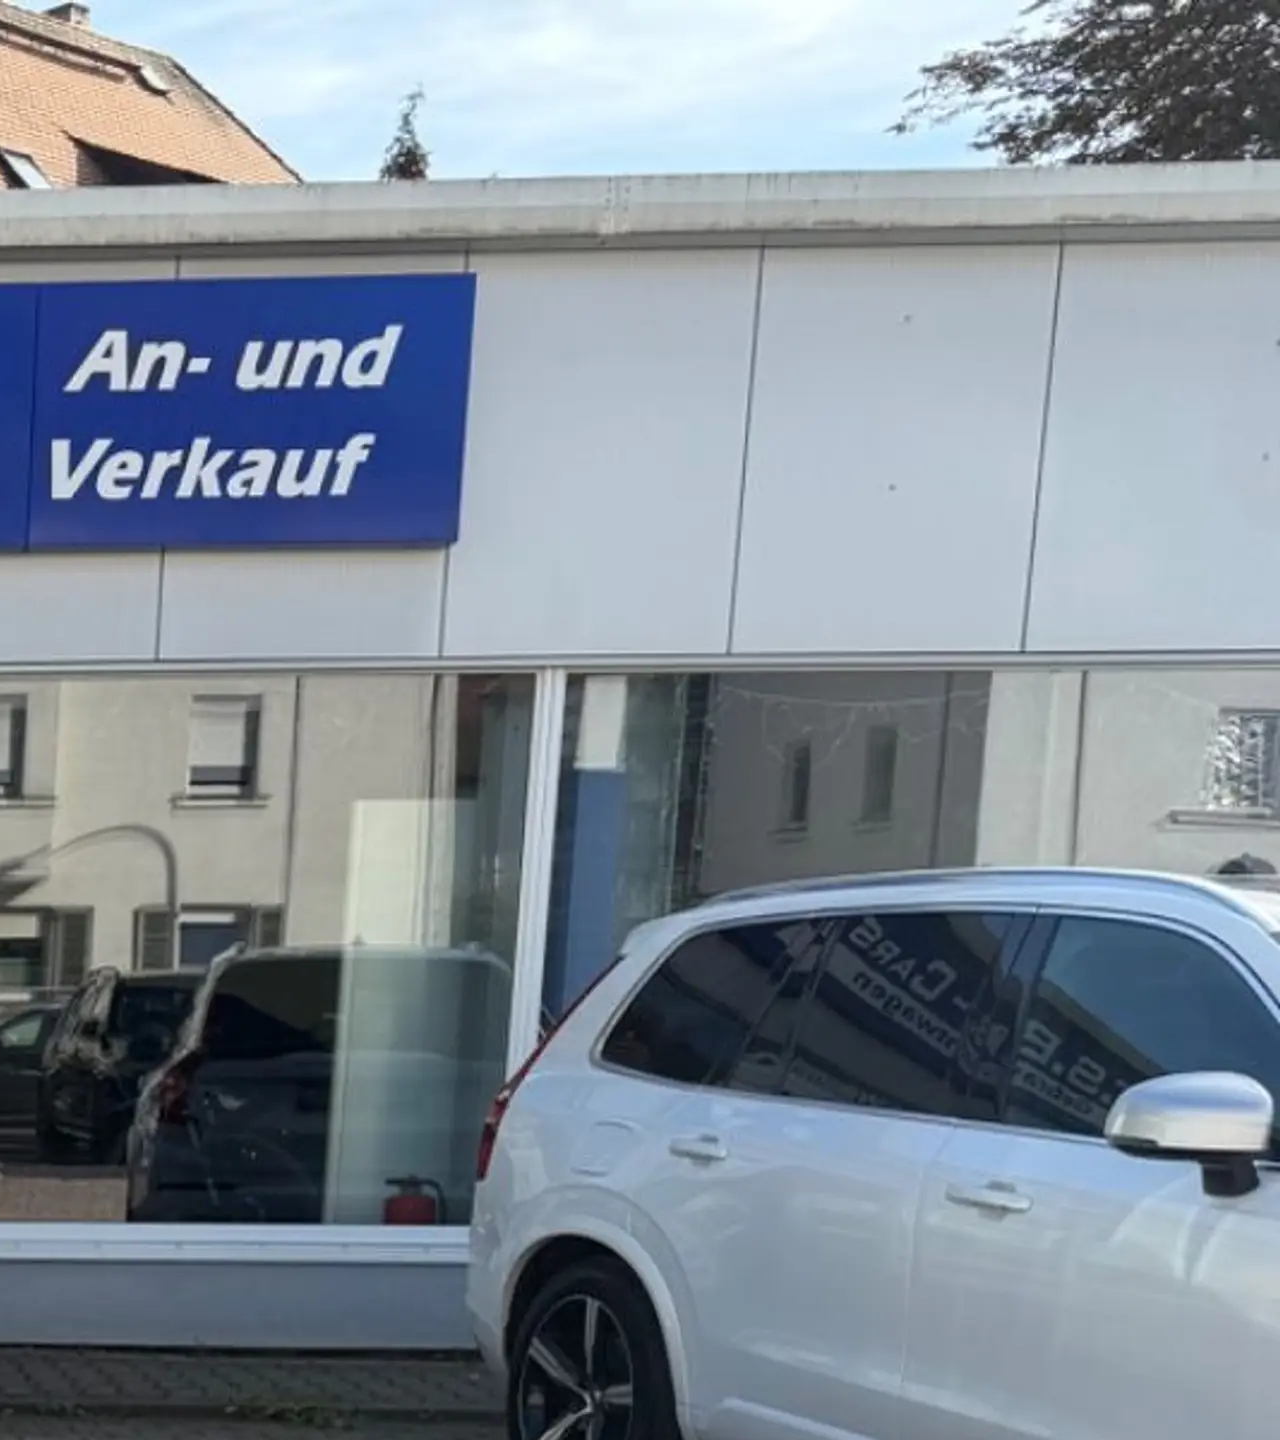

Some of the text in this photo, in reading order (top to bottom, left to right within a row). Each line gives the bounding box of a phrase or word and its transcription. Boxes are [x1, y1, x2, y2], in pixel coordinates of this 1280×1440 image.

[62, 323, 404, 392] An- und
[49, 432, 377, 501] Verkauf
